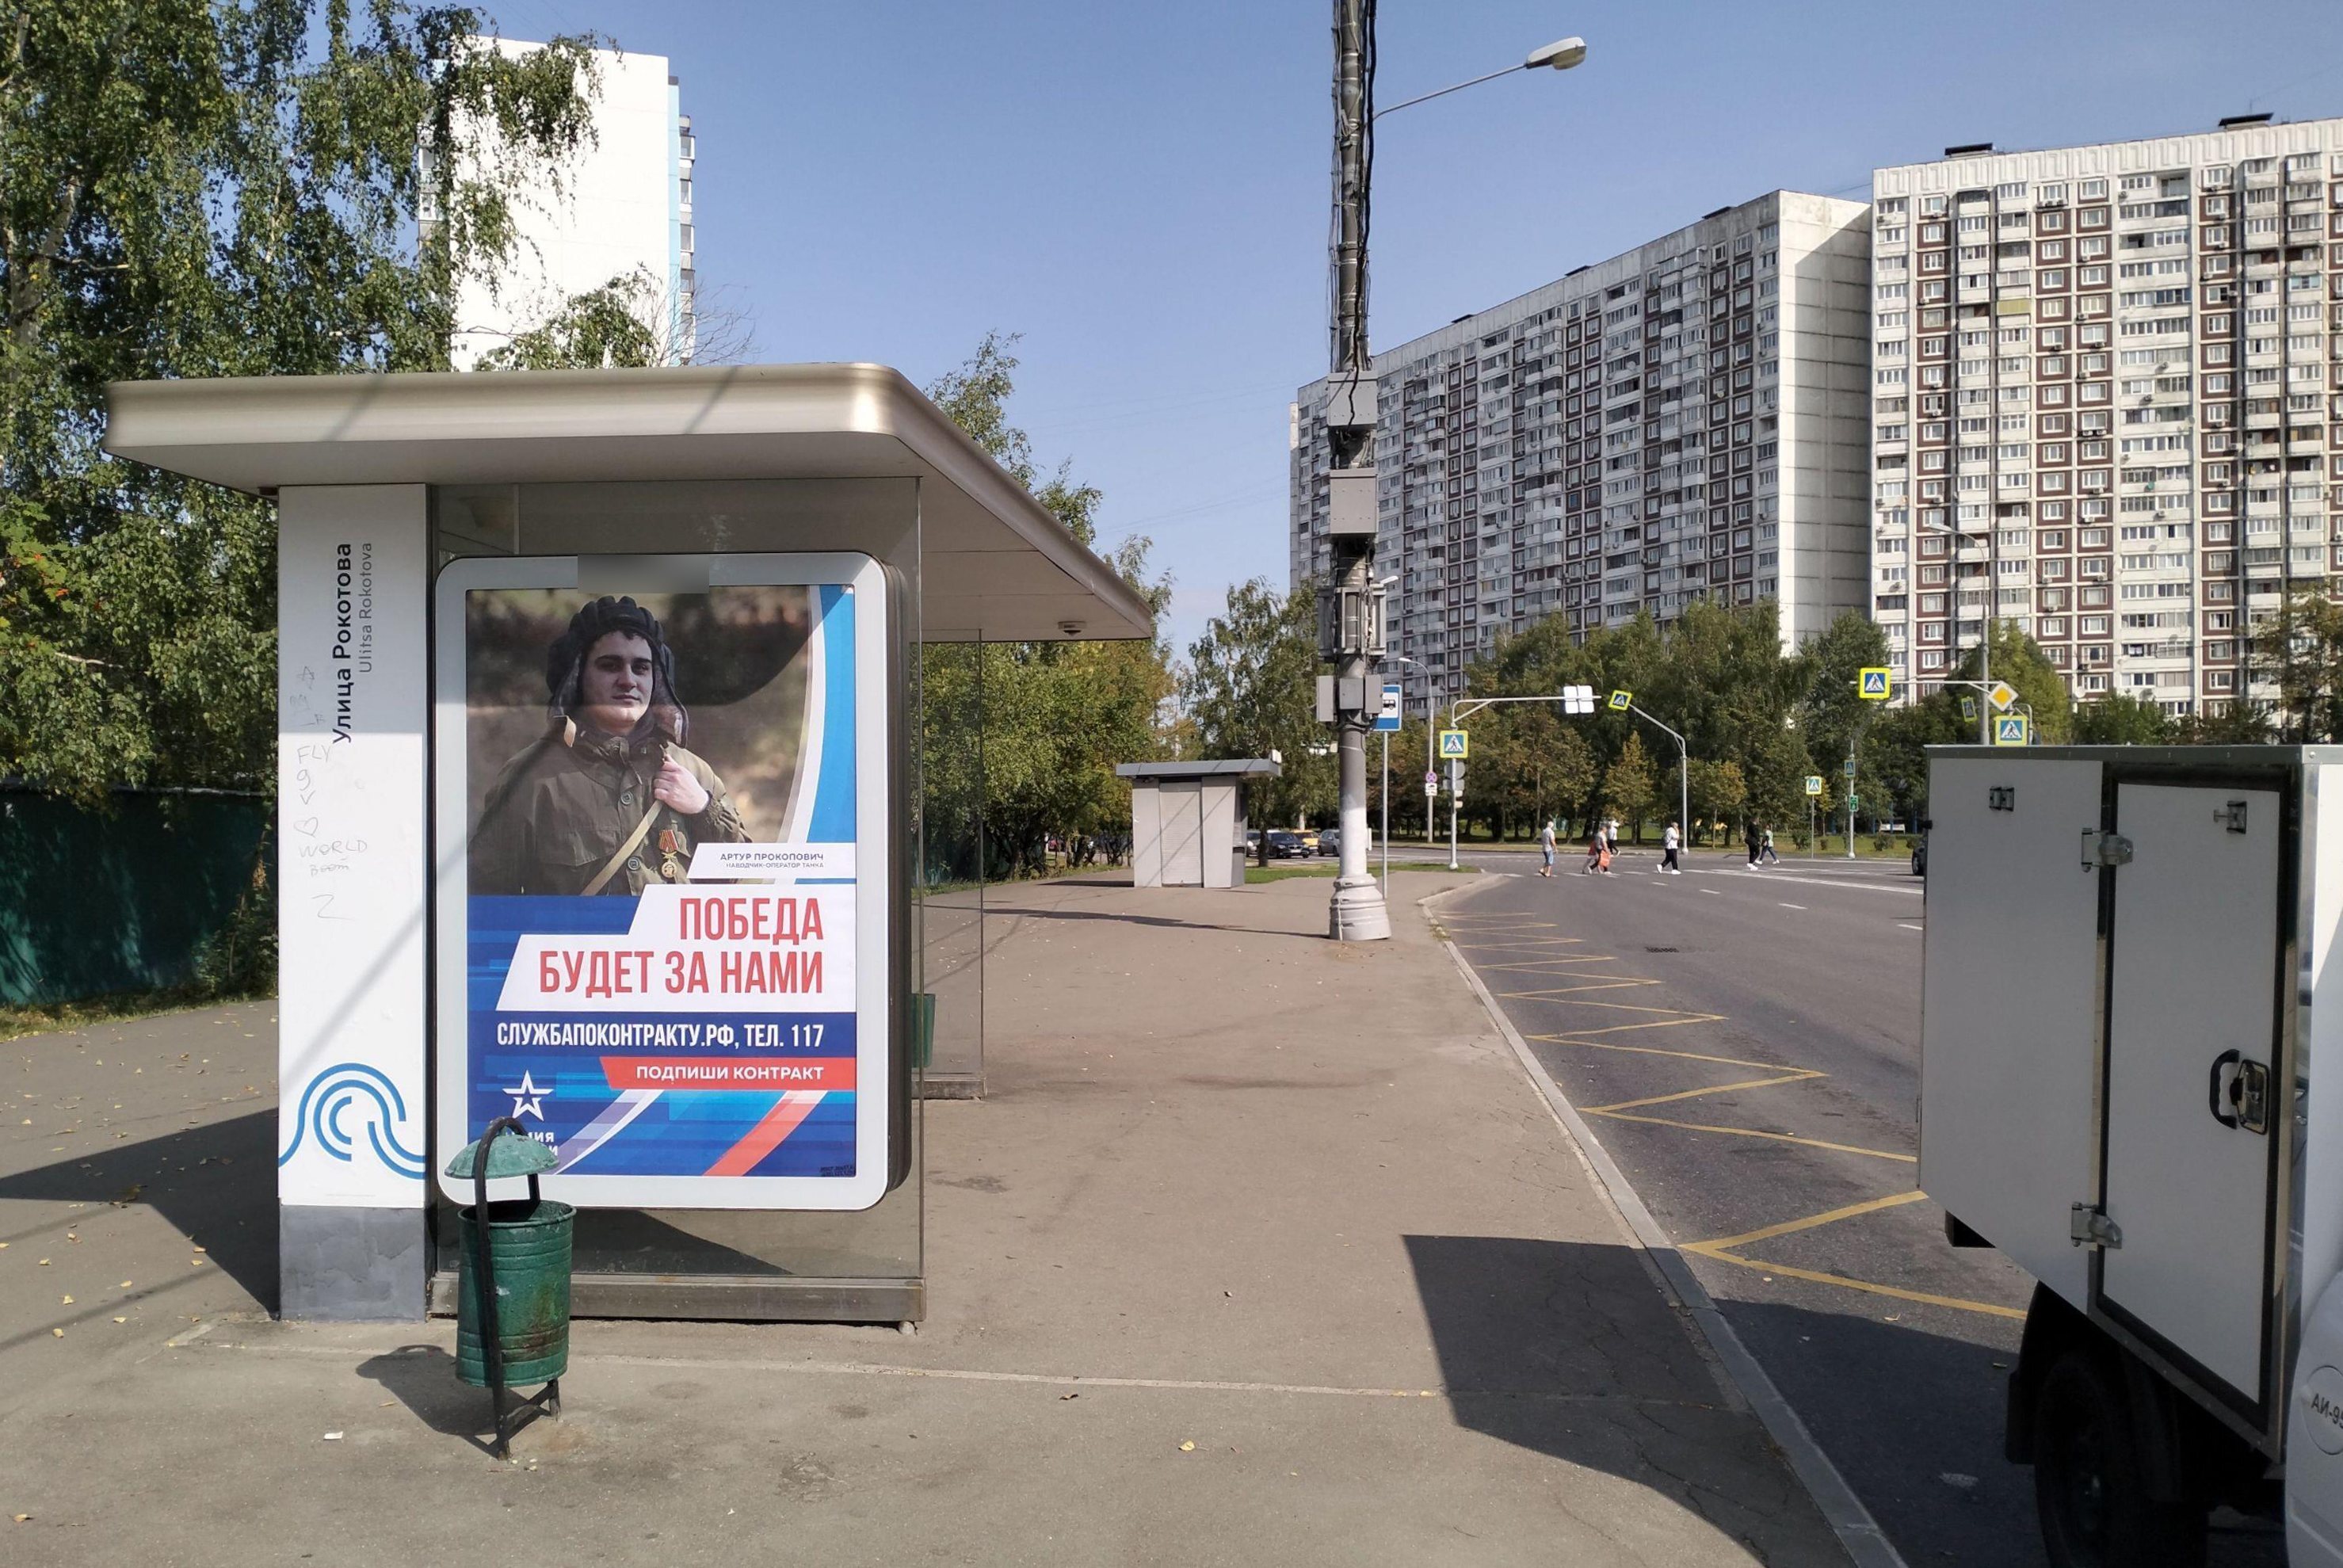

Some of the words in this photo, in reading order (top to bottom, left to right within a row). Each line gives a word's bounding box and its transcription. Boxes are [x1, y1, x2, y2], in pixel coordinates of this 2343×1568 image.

[332, 543, 352, 659] Рокотова
[358, 542, 372, 620] Rokotova
[358, 624, 372, 673] Ulitsa
[332, 668, 354, 744] Улица
[679, 897, 824, 946] ПОБЕДА
[539, 951, 654, 998] БУДЕТ
[664, 951, 710, 994] ЗА
[719, 951, 823, 994] НАМИ
[496, 1021, 740, 1050] СЛУЖБАПОКОНТРАКТУ.РФ,
[743, 1024, 784, 1047] ТЕЛ.
[791, 1024, 825, 1047] 117
[635, 1066, 730, 1082] ПОДПИШИ
[733, 1066, 825, 1081] КОНТРАКТ
